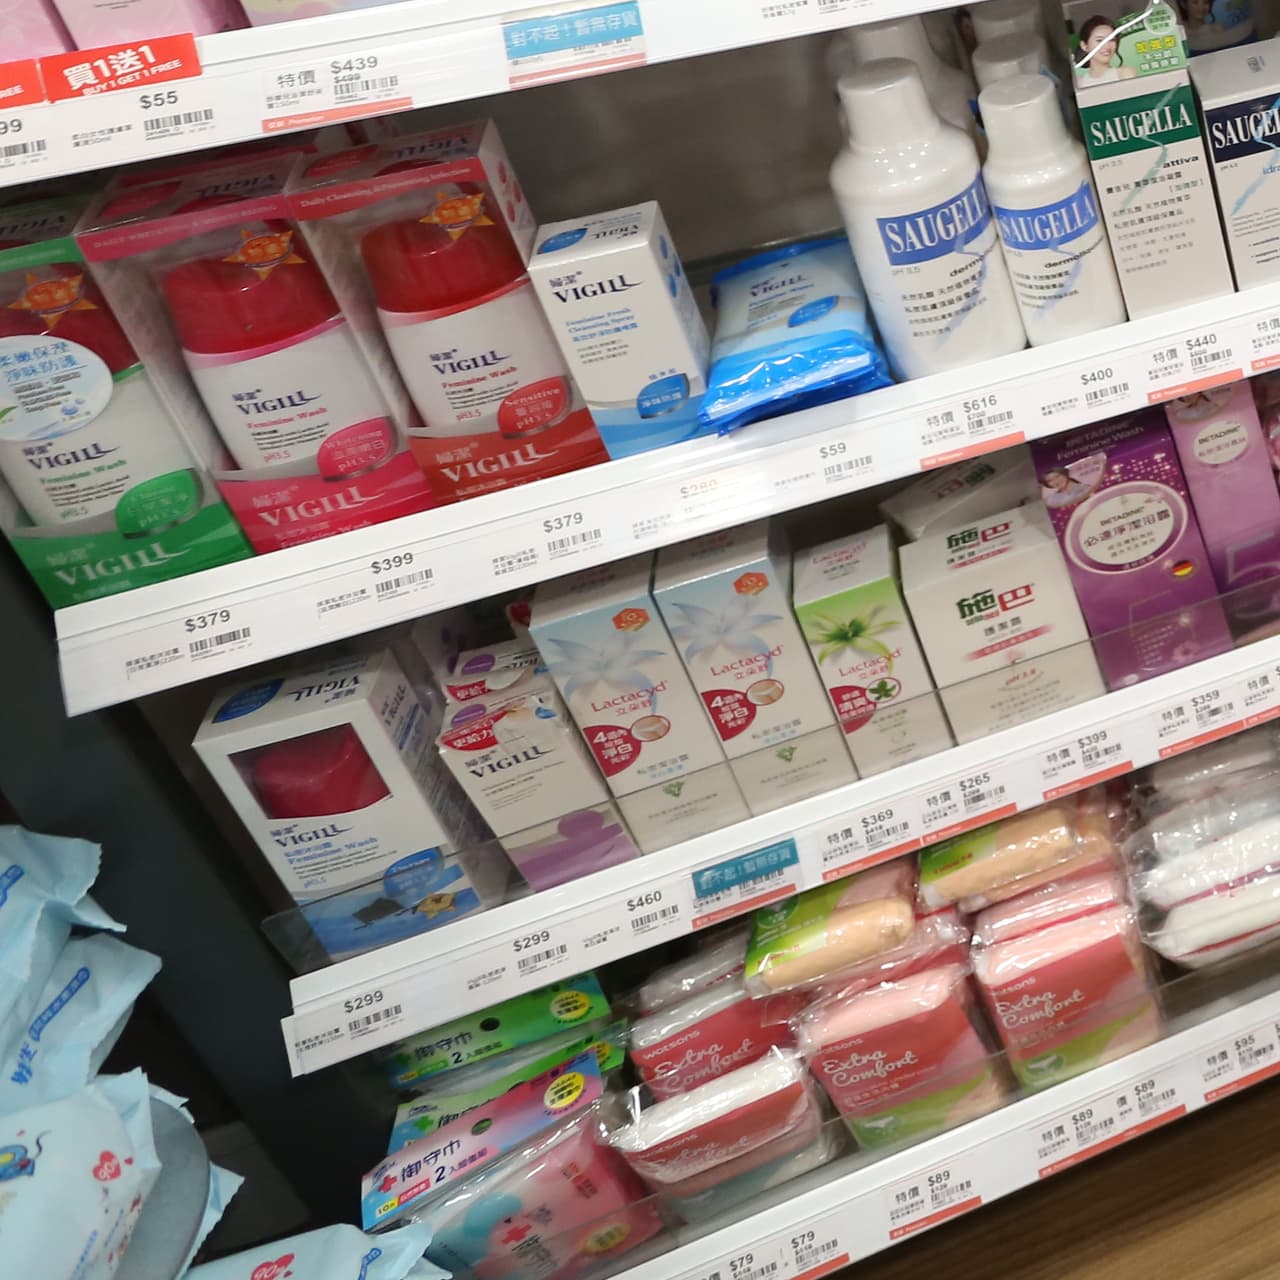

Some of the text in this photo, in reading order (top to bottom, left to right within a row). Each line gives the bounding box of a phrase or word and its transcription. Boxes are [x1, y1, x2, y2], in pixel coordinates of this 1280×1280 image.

[62, 44, 157, 91] 買1送1
[277, 56, 379, 89] 特價 $439
[139, 91, 178, 109] $55
[1090, 102, 1193, 148] SAUGELLA
[1163, 155, 1199, 169] attiva
[1000, 191, 1099, 244] SAUGELLA
[552, 274, 642, 304] VIGILL
[1152, 333, 1217, 363] 特價 $440
[1081, 368, 1114, 385] $400
[926, 395, 997, 426] 特價 $616
[819, 442, 847, 460] $59
[442, 443, 558, 484] VIGILL
[259, 485, 386, 528] VIGILL
[542, 512, 584, 533] $379
[370, 552, 415, 575] $399
[185, 608, 231, 633] $379
[709, 646, 784, 678] Lactacyd
[590, 679, 668, 714] Lactacyd
[626, 890, 662, 912] $460
[512, 930, 550, 953] $299
[344, 990, 384, 1014] $299
[822, 1049, 885, 1074] Extra
[1134, 1079, 1155, 1096] $89
[1072, 1108, 1094, 1125] $89
[790, 1230, 815, 1249] $79
[729, 1253, 754, 1272] $79
